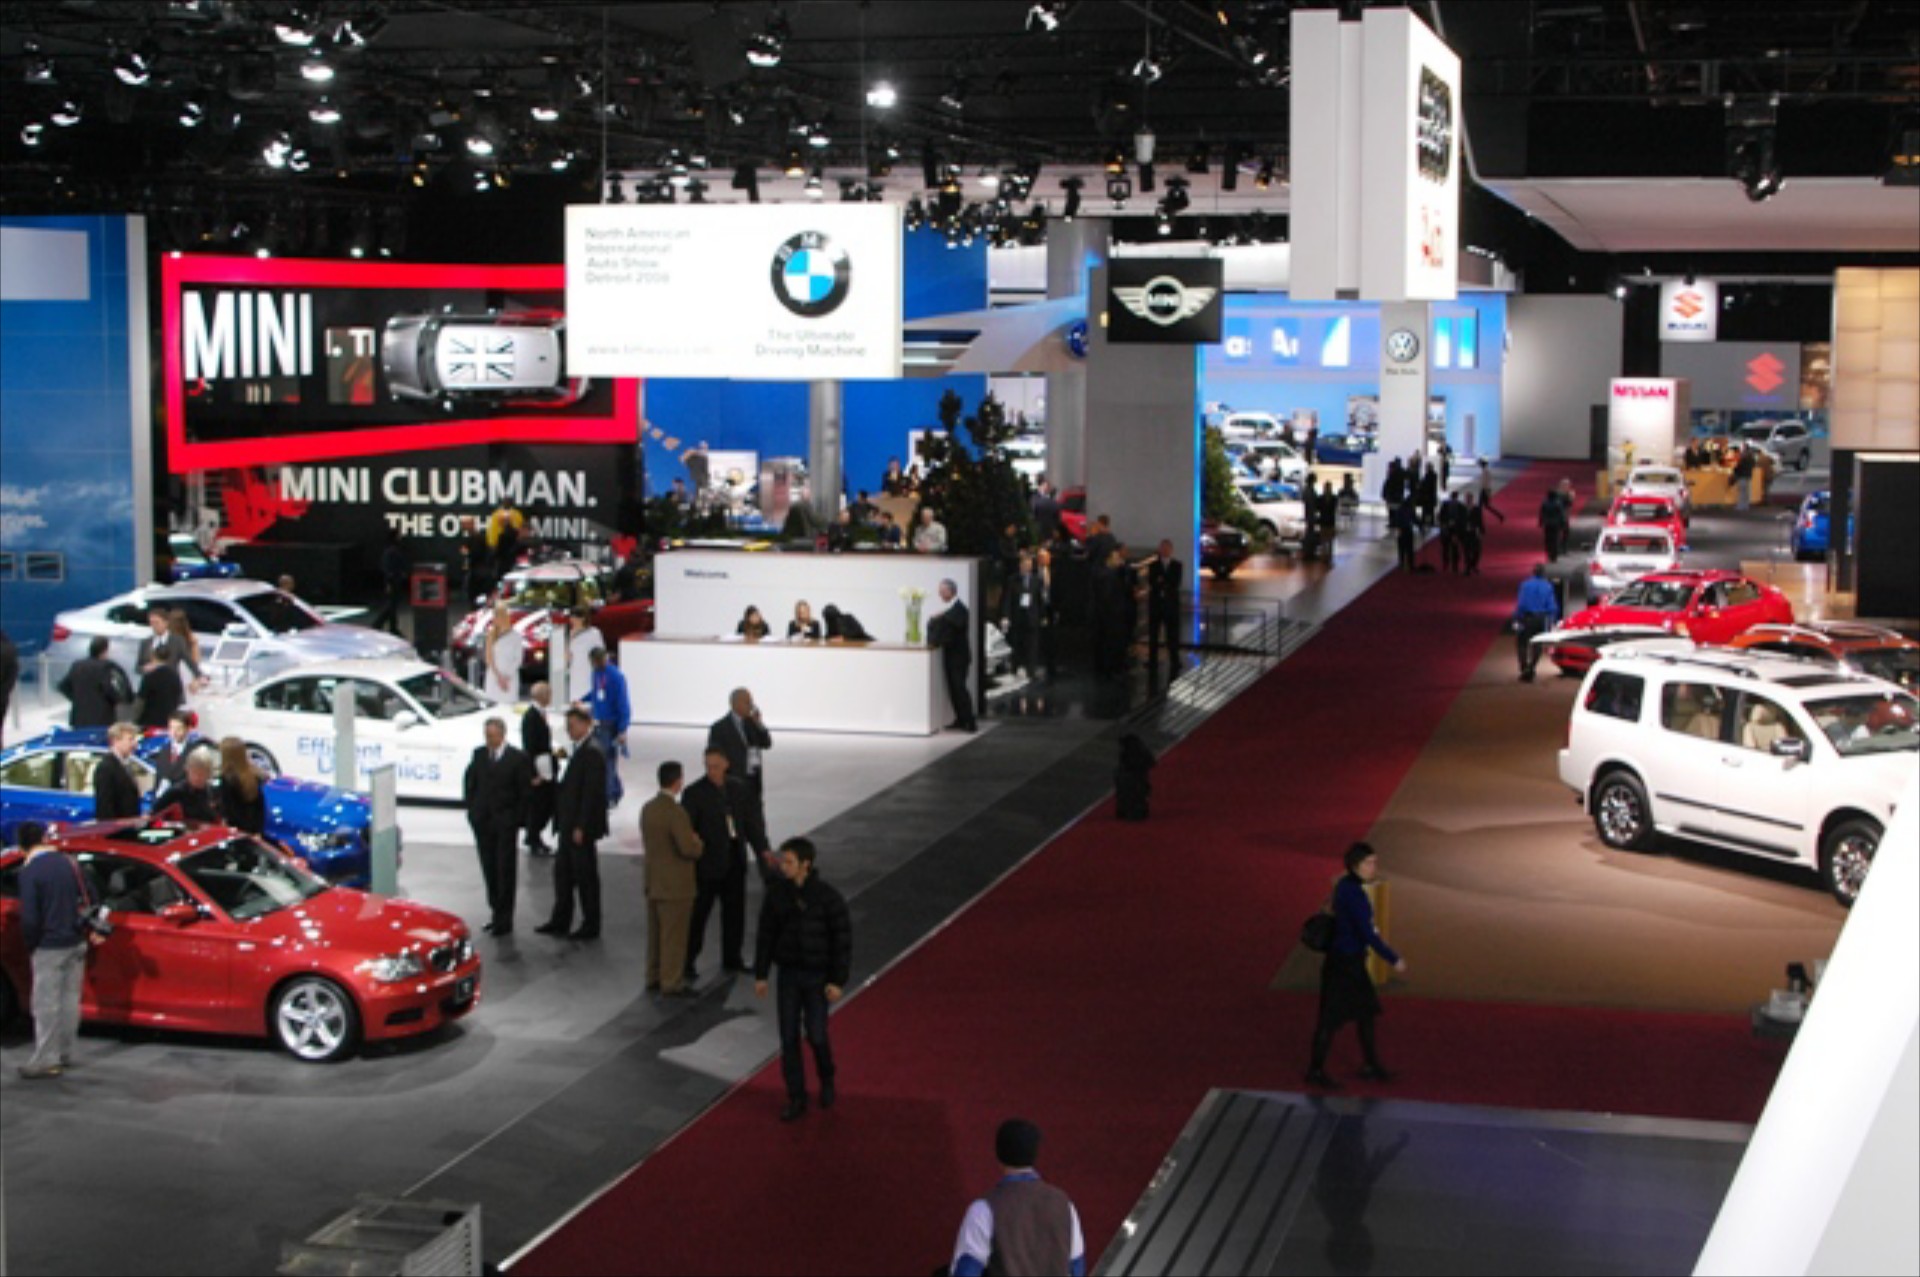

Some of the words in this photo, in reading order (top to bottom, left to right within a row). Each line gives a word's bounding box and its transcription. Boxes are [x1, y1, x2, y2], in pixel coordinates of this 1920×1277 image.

[585, 227, 624, 239] North
[626, 227, 691, 239] American
[585, 242, 673, 255] International
[586, 257, 618, 268] Auto
[621, 257, 659, 268] Show
[585, 271, 633, 285] Detroit
[182, 291, 313, 379] MINI
[768, 329, 793, 341] The
[795, 328, 855, 342] Ultimate
[755, 344, 805, 359] Driving
[807, 344, 867, 357] Machine
[1613, 383, 1669, 398] NISSAN
[279, 466, 371, 501] MINI
[381, 467, 599, 507] CLUBMAN.
[383, 511, 434, 537] THE
